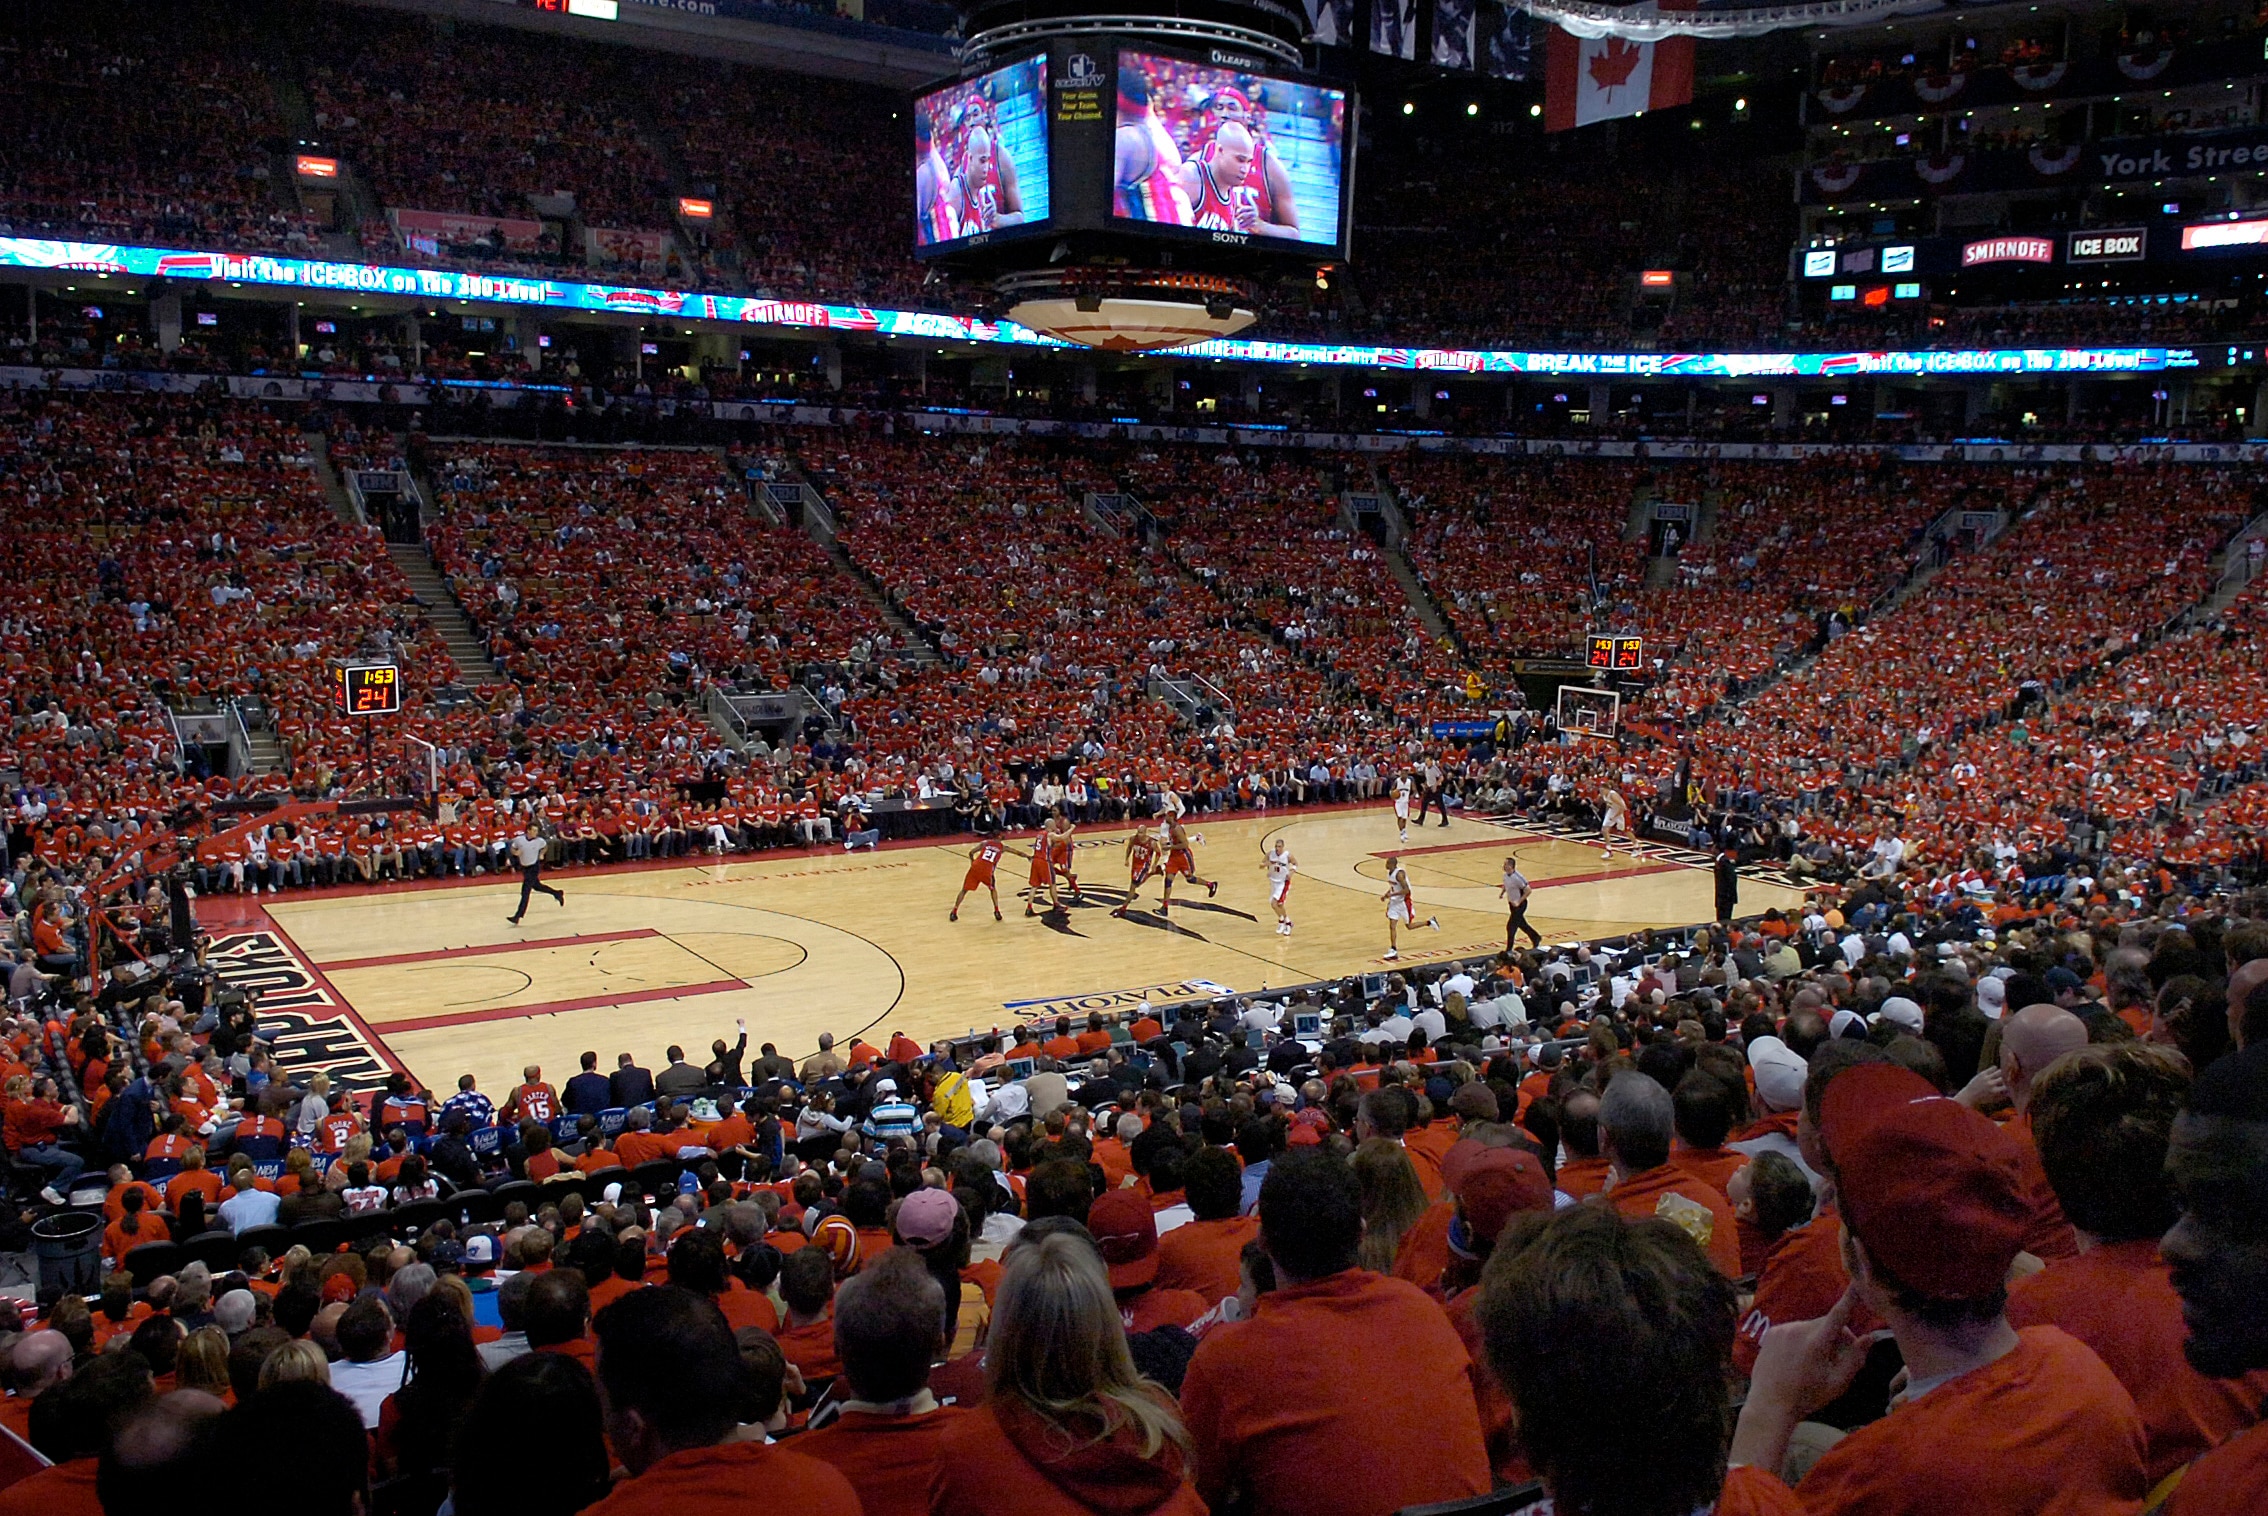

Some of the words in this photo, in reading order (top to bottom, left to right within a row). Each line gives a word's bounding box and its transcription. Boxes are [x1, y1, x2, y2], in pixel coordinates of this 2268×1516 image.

[2100, 149, 2171, 176] York
[1212, 232, 1249, 245] SONY
[2074, 239, 2101, 256] ICE
[2104, 237, 2139, 255] BOX
[211, 254, 257, 278] Visit
[260, 258, 295, 282] the
[304, 265, 337, 286] ICE
[344, 268, 388, 289] BOX
[393, 275, 417, 292] on
[458, 274, 494, 297] 300
[745, 303, 824, 326] SMIRNOFF
[1527, 354, 1597, 371] BREAK
[1601, 354, 1626, 368] THE
[1630, 354, 1663, 373] ICE
[1929, 355, 1957, 370] ICE
[1959, 354, 1997, 369] BOX
[361, 475, 396, 490] IBM
[1591, 651, 1609, 666] 24
[1619, 651, 1637, 667] 24
[357, 687, 389, 710] 24
[1659, 819, 1688, 831] PLAYOFF
[981, 849, 998, 863] 21
[778, 866, 867, 878] CANADA
[1013, 984, 1197, 1019] PLAYOFFS
[523, 1091, 550, 1104] CARTER
[527, 1101, 550, 1120] 15
[334, 1128, 348, 1148] 2
[256, 1164, 279, 1178] NBA
